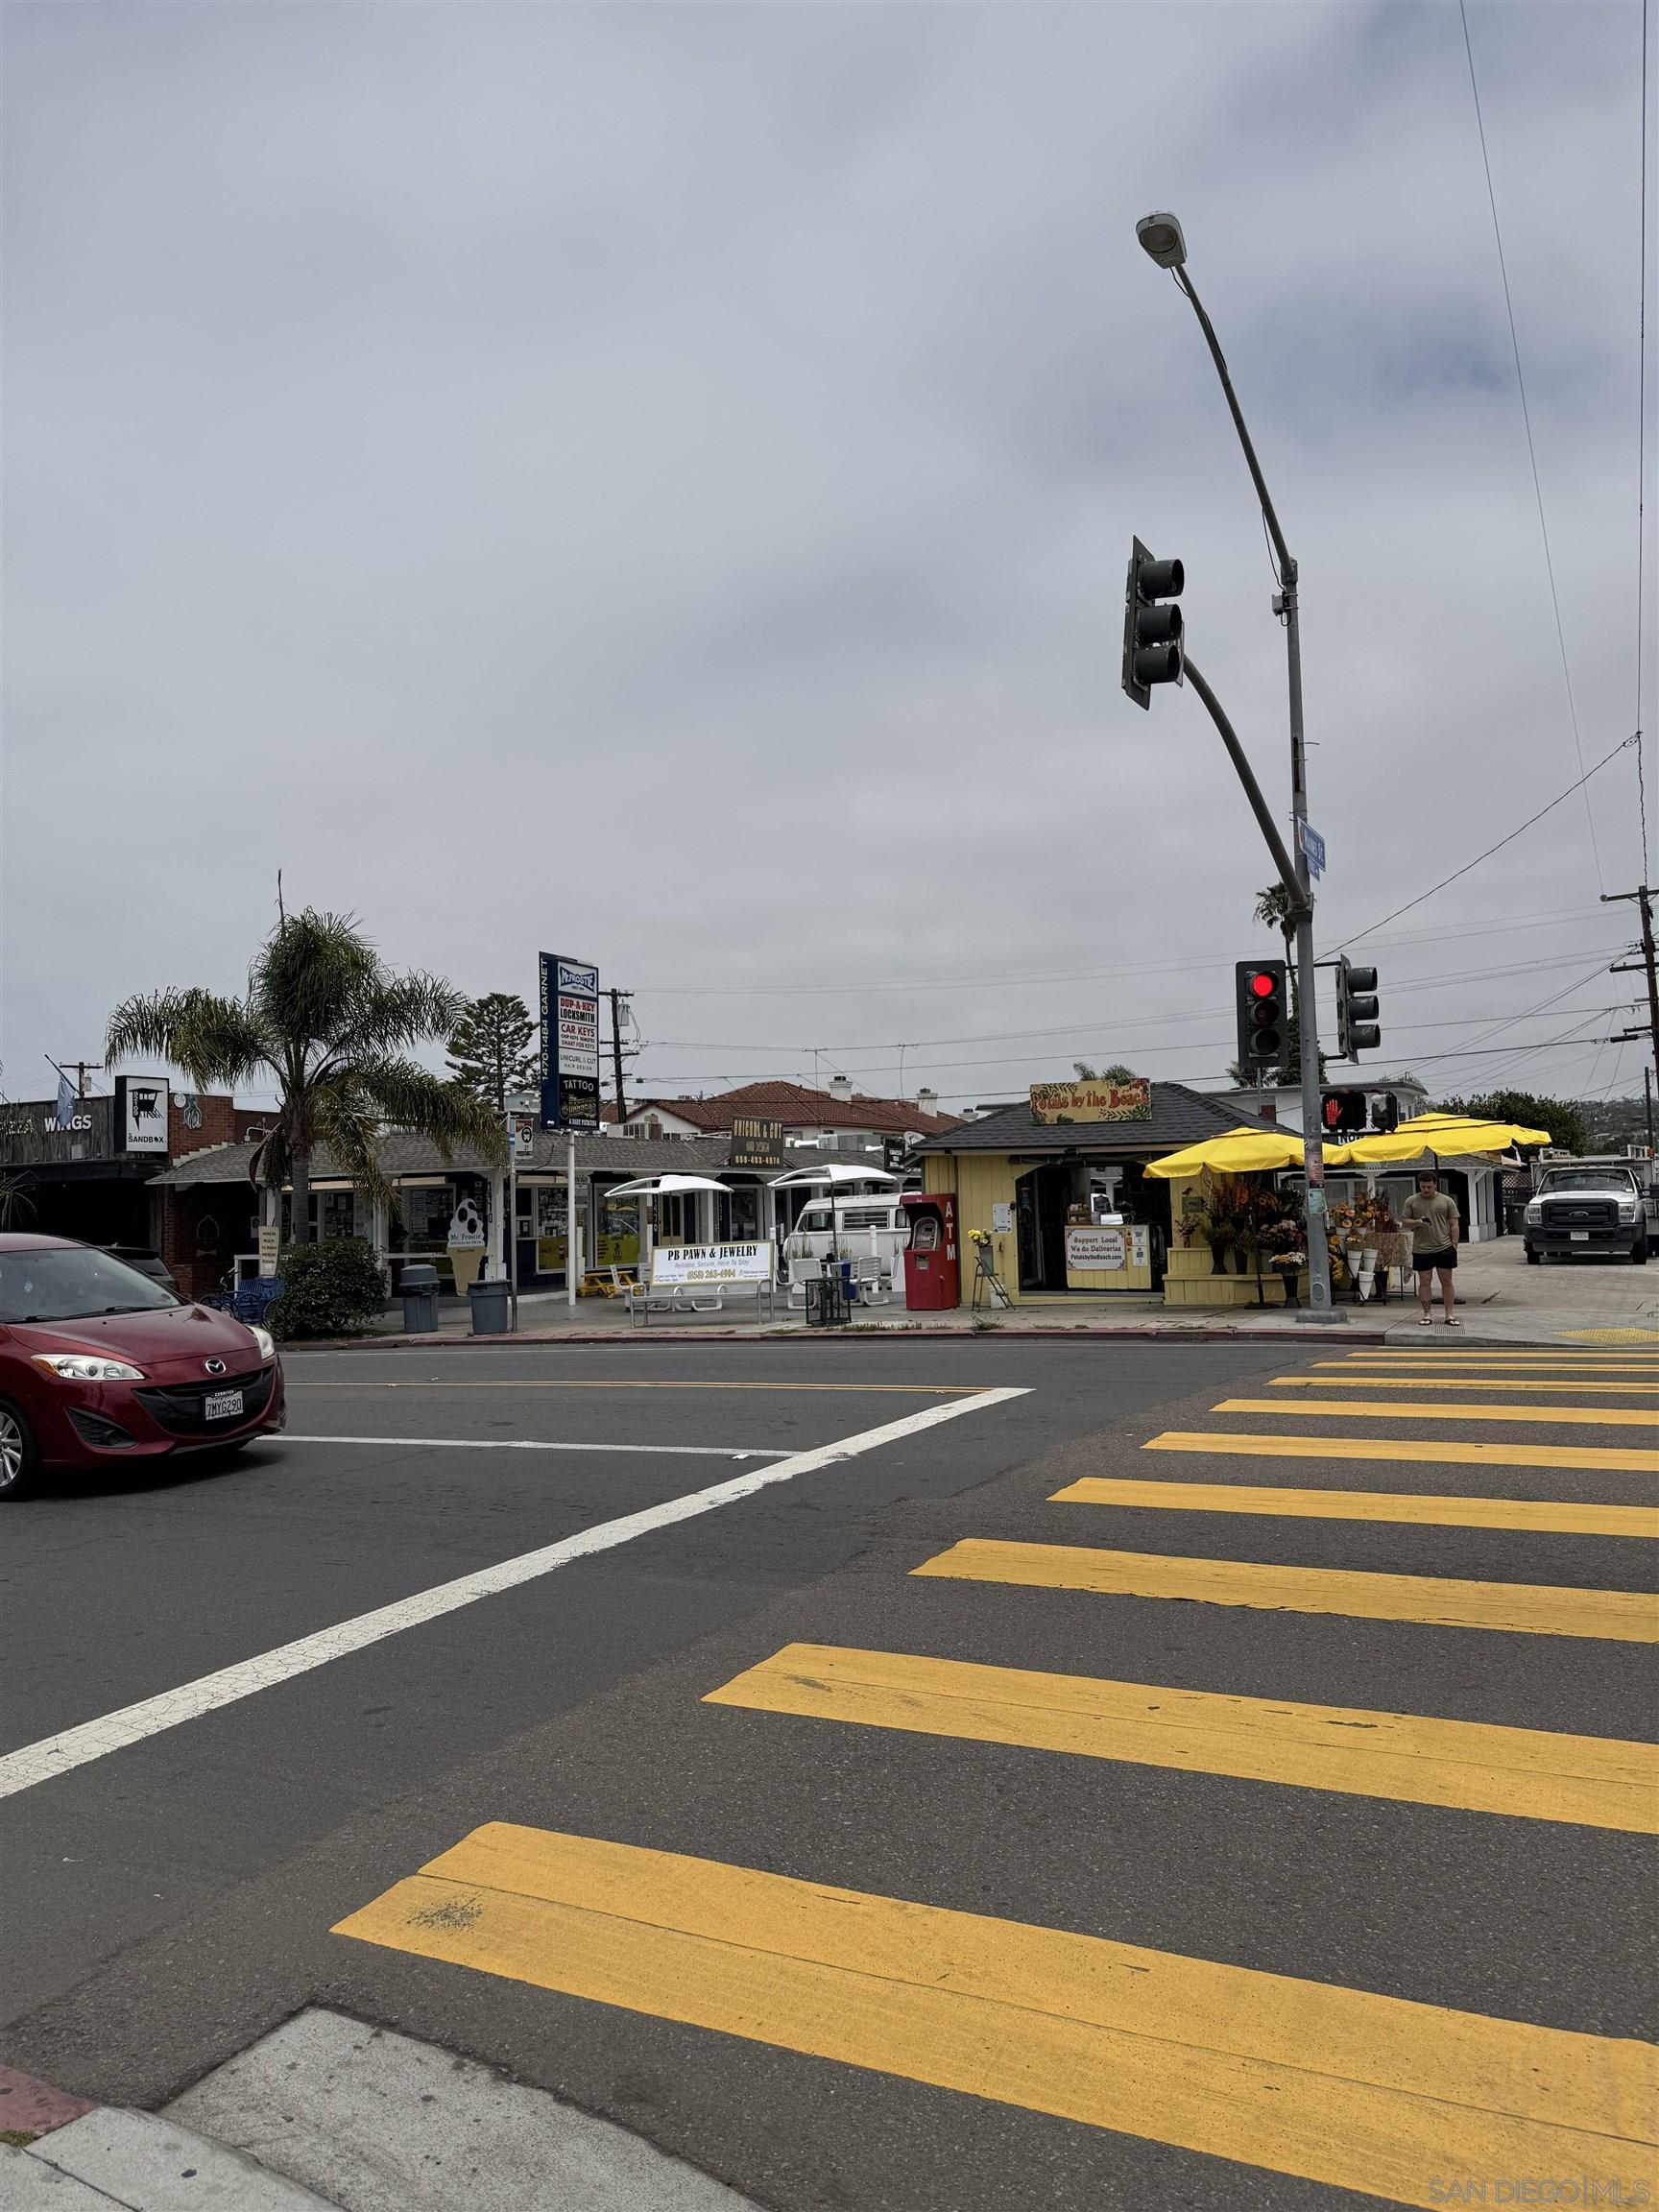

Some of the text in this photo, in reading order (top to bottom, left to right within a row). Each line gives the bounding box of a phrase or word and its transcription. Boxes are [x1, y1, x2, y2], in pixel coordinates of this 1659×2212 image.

[560, 1008, 595, 1023] LOCKSMITH
[561, 1023, 595, 1038] CAR KEYS
[560, 1054, 582, 1064] UNICURL
[564, 1080, 594, 1092] TATTOO
[1031, 1090, 1149, 1114] Petals by the Beach
[733, 1119, 760, 1138] UNICURL
[769, 1122, 781, 1139] CUT
[128, 1135, 164, 1143] SANDBOX
[945, 1201, 956, 1261] ATM
[667, 1245, 757, 1261] PB PAWN & JEWELRY
[738, 1259, 750, 1267] Stay
